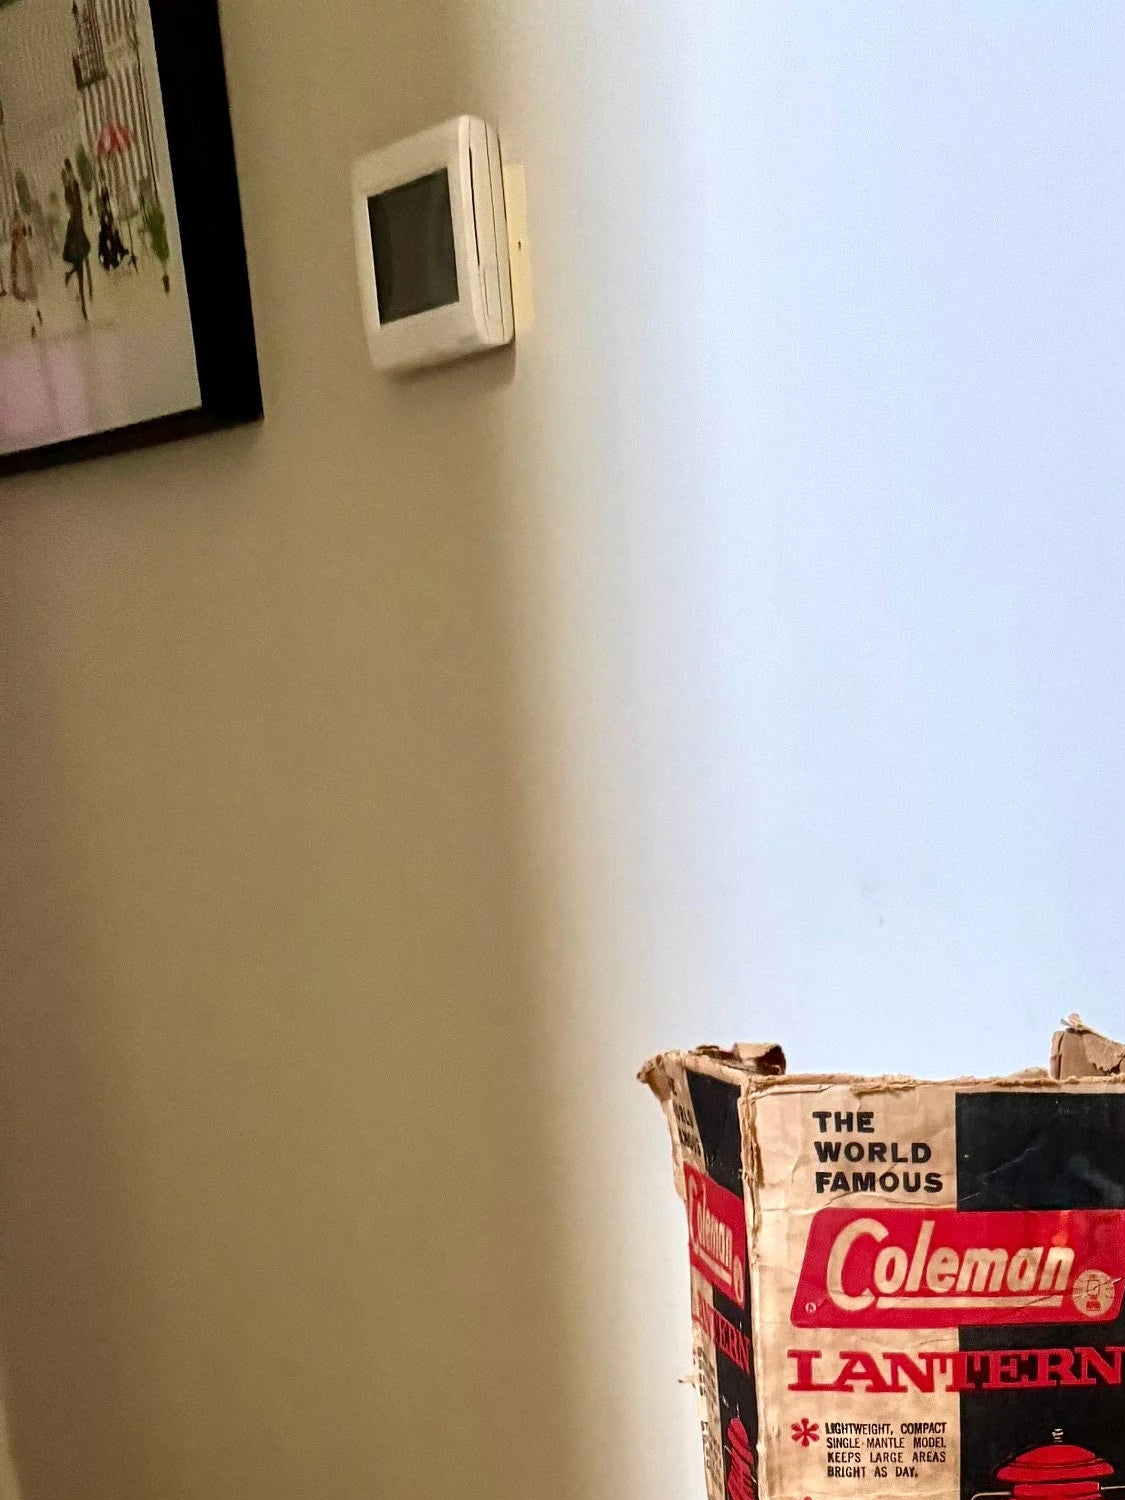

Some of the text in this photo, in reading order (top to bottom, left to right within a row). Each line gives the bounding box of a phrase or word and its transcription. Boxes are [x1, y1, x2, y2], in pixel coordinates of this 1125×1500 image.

[812, 1111, 875, 1134] THE
[813, 1141, 932, 1164] WORLD
[815, 1171, 944, 1194] FAMOUS
[688, 1174, 733, 1274] Coleman
[826, 1217, 1076, 1312] Coleman
[825, 1422, 947, 1436] LIGHTWEIGHT, COMPACT
[913, 1437, 947, 1448] MODEL
[827, 1451, 946, 1463] KEEPS LARGE AREAS
[827, 1466, 919, 1478] BRIGHT AS DAY.
